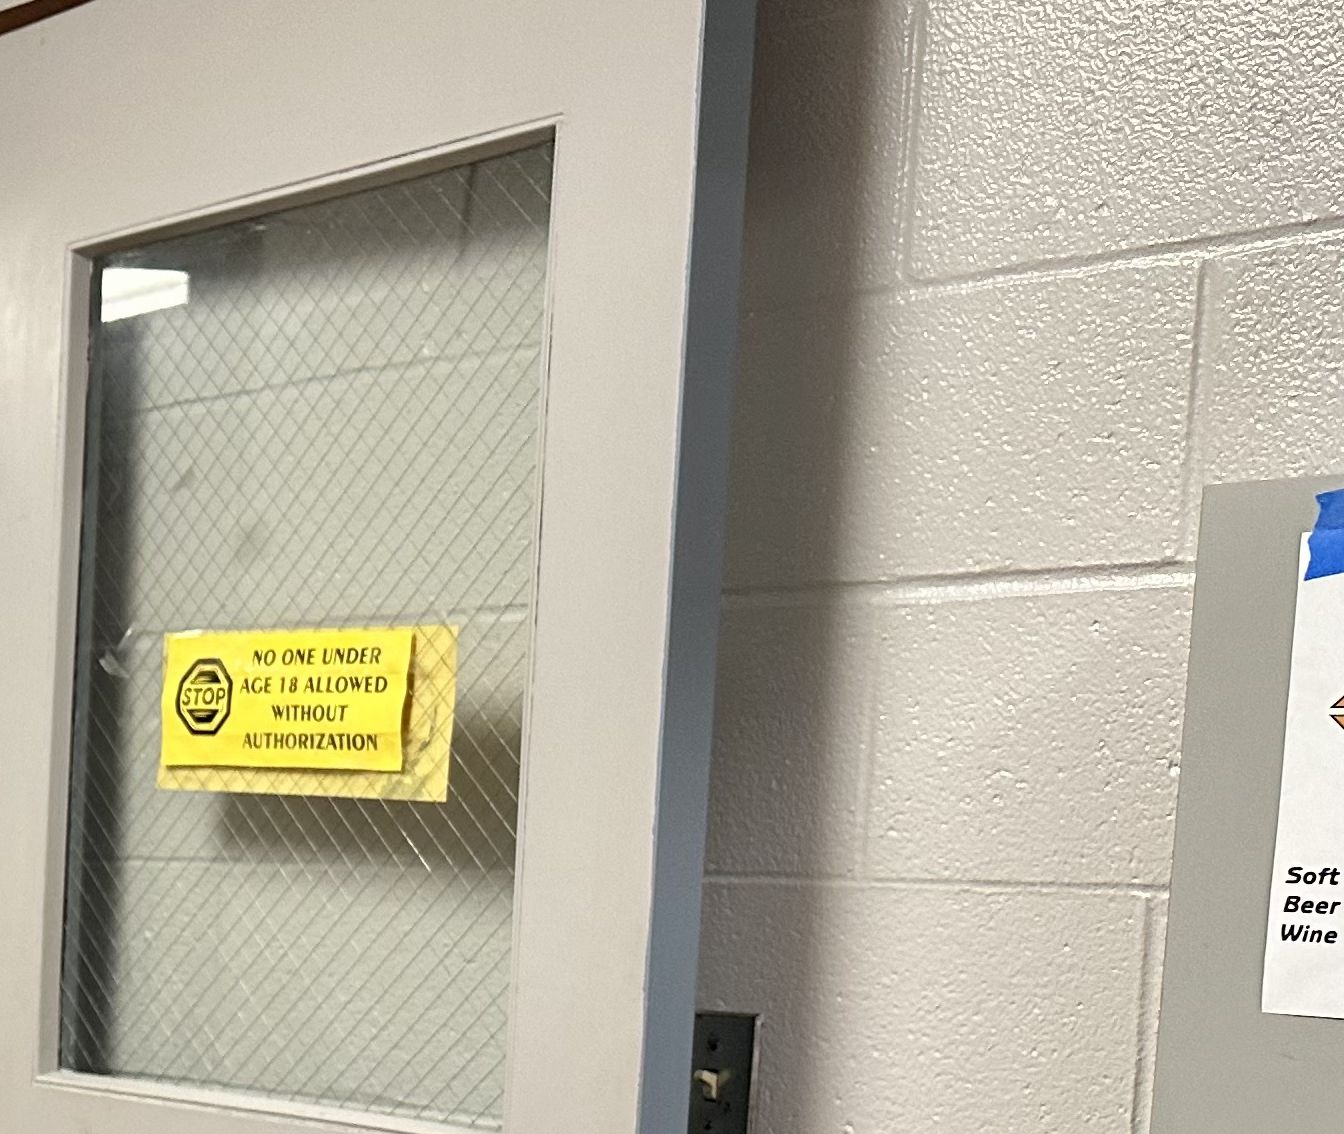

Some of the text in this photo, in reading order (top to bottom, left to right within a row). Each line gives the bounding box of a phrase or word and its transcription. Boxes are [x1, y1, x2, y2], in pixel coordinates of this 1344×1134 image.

[252, 647, 382, 666] NO ONE UNDER
[240, 676, 388, 694] AGE 18 ALLOWED
[182, 687, 226, 706] STOP
[272, 704, 348, 722] WITHOUT
[242, 733, 378, 751] AUTHORIZATION
[1285, 866, 1341, 886] Soft
[1283, 895, 1342, 915] Beer
[1281, 923, 1338, 944] Wine
